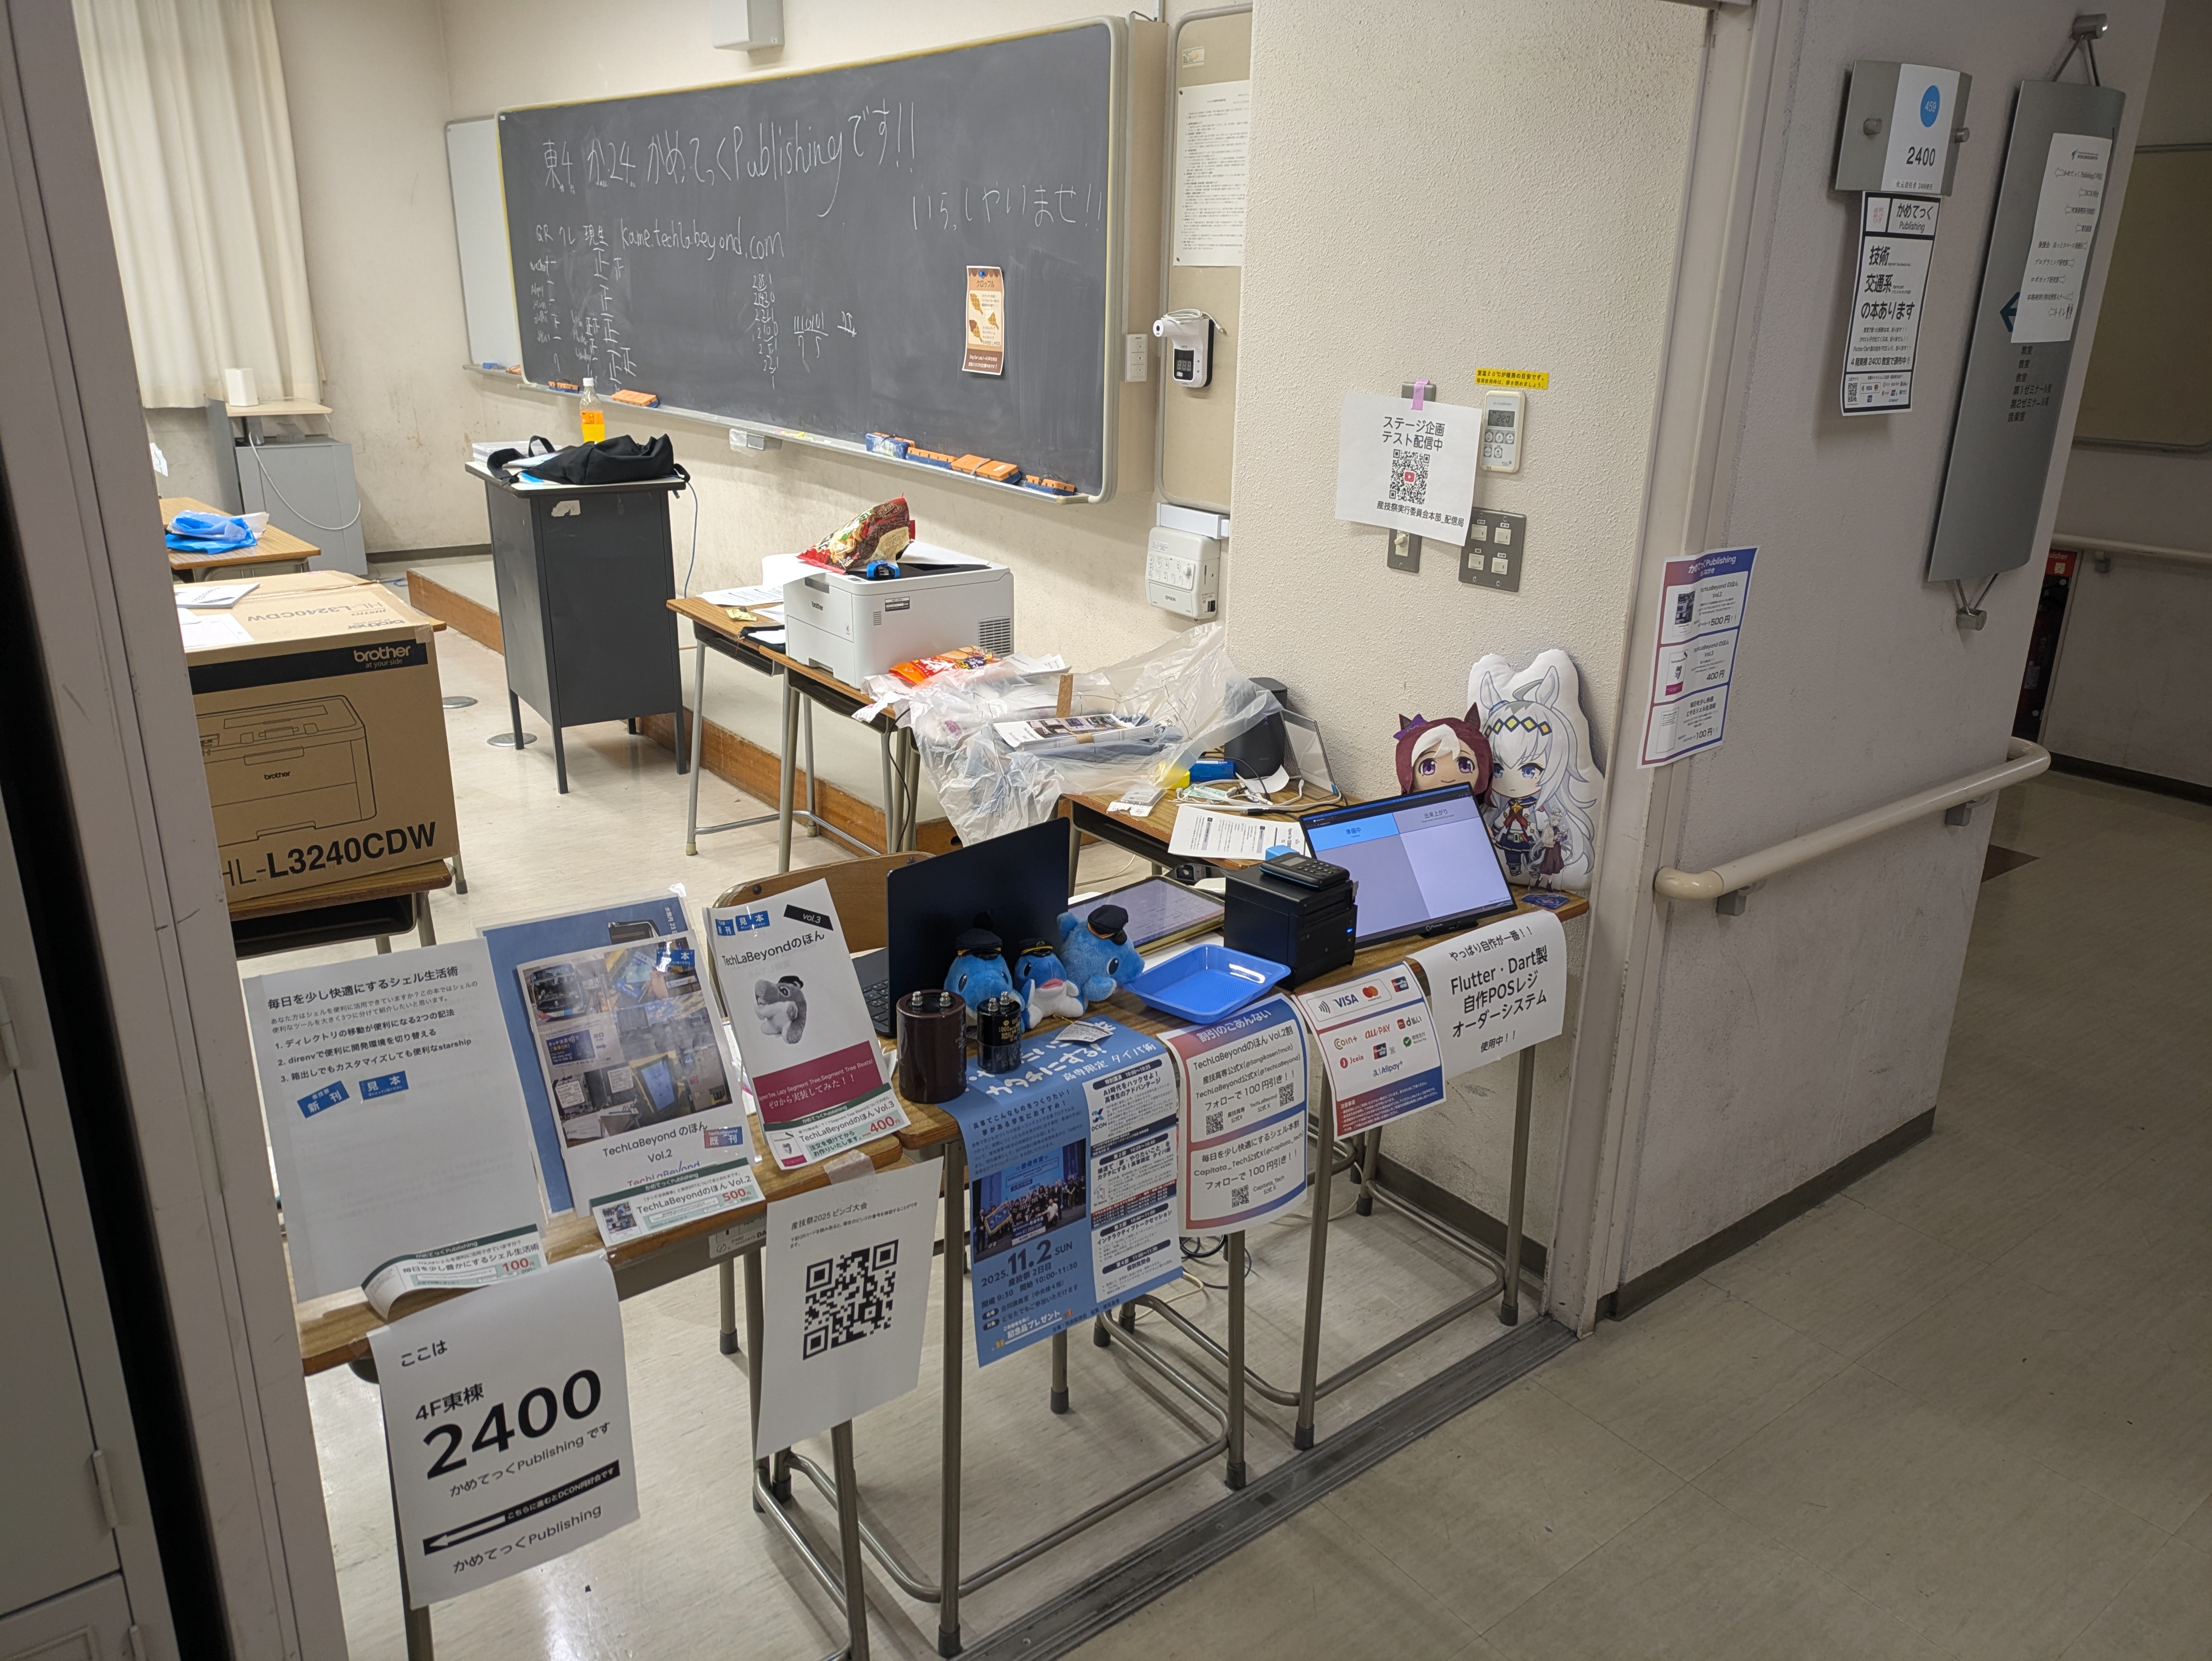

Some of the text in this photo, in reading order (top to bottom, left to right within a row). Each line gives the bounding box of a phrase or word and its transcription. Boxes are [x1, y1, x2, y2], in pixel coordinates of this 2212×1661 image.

[1925, 101, 1936, 112] 459
[1906, 146, 1936, 167] 2400
[1896, 180, 1917, 190] 火元責任者
[1896, 203, 1934, 221] かめてっく
[1899, 221, 1925, 233] Publishing
[1869, 245, 1891, 266] 技術
[1864, 273, 1893, 293] 交通系
[1861, 300, 1915, 320] の本あります
[2021, 345, 2033, 355] 教室
[2018, 359, 2030, 368] 教室
[2016, 373, 2027, 382] 教室
[1383, 416, 1445, 437] ステージ企画
[2008, 412, 2025, 422] 音楽室
[1382, 432, 1443, 451] テスト配信中
[1376, 500, 1464, 527] 産技祭実行委員会本部_配信局
[247, 601, 382, 622] HL-L3240CDW
[812, 601, 824, 610] brother
[347, 620, 405, 630] brother
[1711, 616, 1724, 626] 500
[353, 645, 411, 662] brother
[374, 660, 388, 669] your
[389, 657, 403, 665] side
[1696, 731, 1707, 740] 100
[264, 770, 291, 780] brother
[1424, 808, 1448, 819] 出来上がり
[1345, 827, 1361, 835] 準備中
[669, 922, 676, 930] 23
[803, 914, 821, 924] vol.3
[722, 930, 824, 966] TechLaBeyondのほん
[1449, 926, 1533, 961] やっぱり自作が一番！！
[680, 952, 690, 961] 本
[267, 965, 458, 1009] 毎日を少し快適にするシェル生活術
[1464, 970, 1538, 1014] 自作POSレジ
[271, 981, 477, 1024] あなた方はシェルを便利に活用できていますか？この本ではシェルの
[1332, 993, 1359, 1008] VISA
[272, 996, 450, 1034] 便利なツールを大きく3つに分けて紹介したいと思います。
[1452, 989, 1547, 1038] オーダーシステム
[286, 1009, 455, 1048] ディレクトリの移動が便利になる2つの記法
[1198, 1009, 1272, 1042] 割引のごあんない
[1365, 1016, 1422, 1039] au PAY d払い
[277, 1028, 436, 1067] 2. direnvで便利に開発環境を切り替える
[1193, 1025, 1294, 1071] TechLaBeyondのほん Vol.2割
[1481, 1030, 1515, 1053] 使用中！！
[291, 1038, 472, 1082] 箱出しでもカスタマイズしても便利なstarship
[1062, 1042, 1157, 1082] 高専限定 タイパ術
[777, 1059, 873, 1096] Lazy Segment Tree Beats!
[769, 1074, 854, 1109] ゼロから実装してみた！！
[1105, 1077, 1161, 1104] 高専生のアドバンテージ
[1205, 1091, 1242, 1111] フォローで
[1244, 1083, 1261, 1096] 100
[1227, 1106, 1245, 1118] 産技高専
[1250, 1094, 1277, 1109] TechLaBeyond
[1340, 1099, 1356, 1109] 注意事項
[799, 1101, 895, 1142] TechLaBeyondのほん Vol.3
[802, 1105, 848, 1124] かめてっくPublishing
[982, 1100, 1066, 1136] 夢がある学生におすすめ！
[1091, 1121, 1107, 1132] DCON
[603, 1121, 708, 1157] TechLaBeyond のほん
[809, 1130, 855, 1151] 注文を受けてから
[814, 1136, 862, 1157] お作りいたします。
[1201, 1119, 1300, 1163] 毎日を少し快適にするシェル本割
[648, 1149, 673, 1163] Vol.2
[645, 1173, 698, 1190] かめてっくPublishing
[1205, 1173, 1246, 1190] フォローで
[1249, 1164, 1265, 1177] 100
[1253, 1175, 1285, 1192] Capitata_Tech
[637, 1181, 728, 1215] TechLaBeyondのほん
[728, 1175, 752, 1187] Vol.2
[791, 1202, 868, 1230] 産技祭2025 ビンゴ大会
[1097, 1210, 1172, 1246] インタラクティブトークセッション
[403, 1243, 540, 1273] 毎日を少し豊かにするシェル生活術
[1055, 1241, 1073, 1256] SUN
[1008, 1262, 1051, 1287] 産技祭 2日目
[1127, 1257, 1151, 1272] 個別質問会
[982, 1262, 1078, 1308] 開場 9:30 開始 10:00-11:30
[1007, 1310, 1061, 1339] 記念品プレゼント
[401, 1340, 448, 1367] ここは
[415, 1383, 485, 1421] 4F東棟
[422, 1369, 602, 1480] 2400
[450, 1422, 610, 1497] かめてっくPublishing です
[507, 1467, 614, 1520] こちらに進むとDCON同好会です
[453, 1505, 602, 1574] かめてっくPublishing
